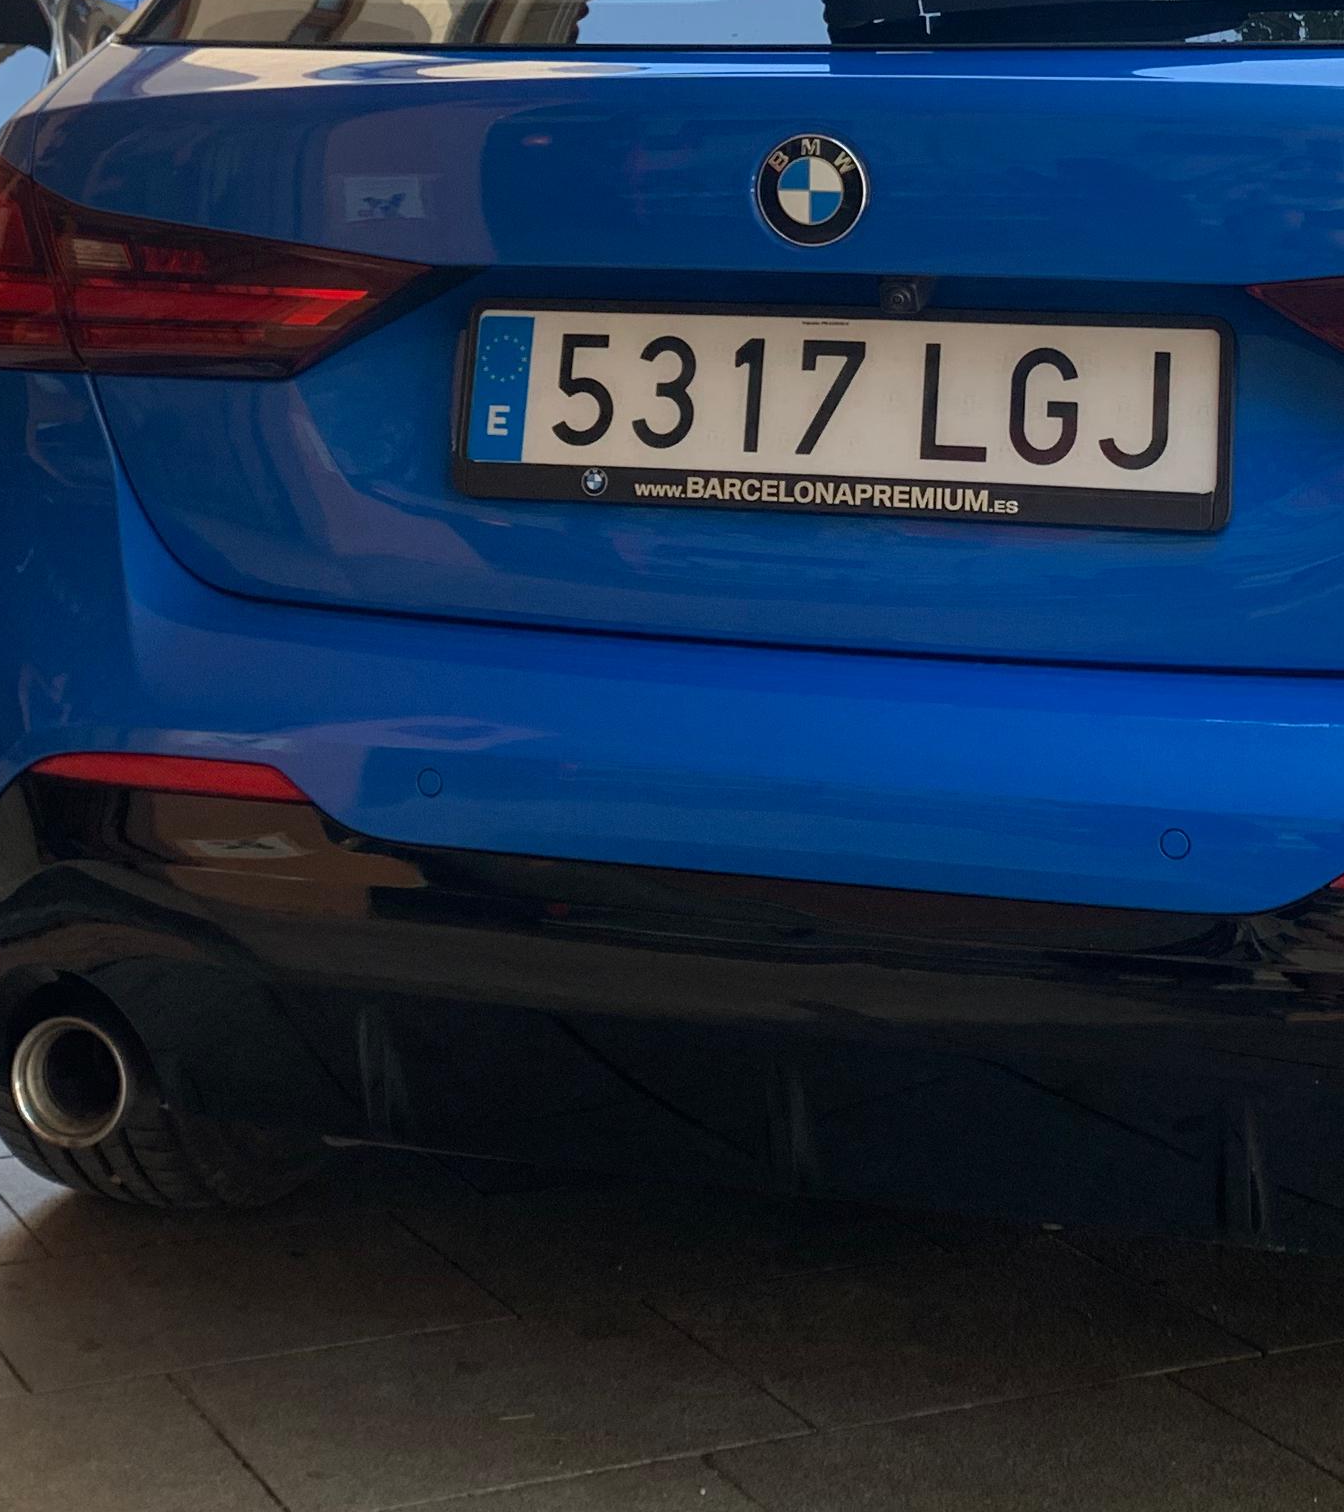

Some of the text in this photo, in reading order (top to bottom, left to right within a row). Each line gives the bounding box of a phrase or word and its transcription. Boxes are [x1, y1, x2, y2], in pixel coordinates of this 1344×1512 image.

[768, 138, 857, 175] BMW
[552, 333, 1172, 471] 5317 LGJ
[486, 405, 511, 437] E
